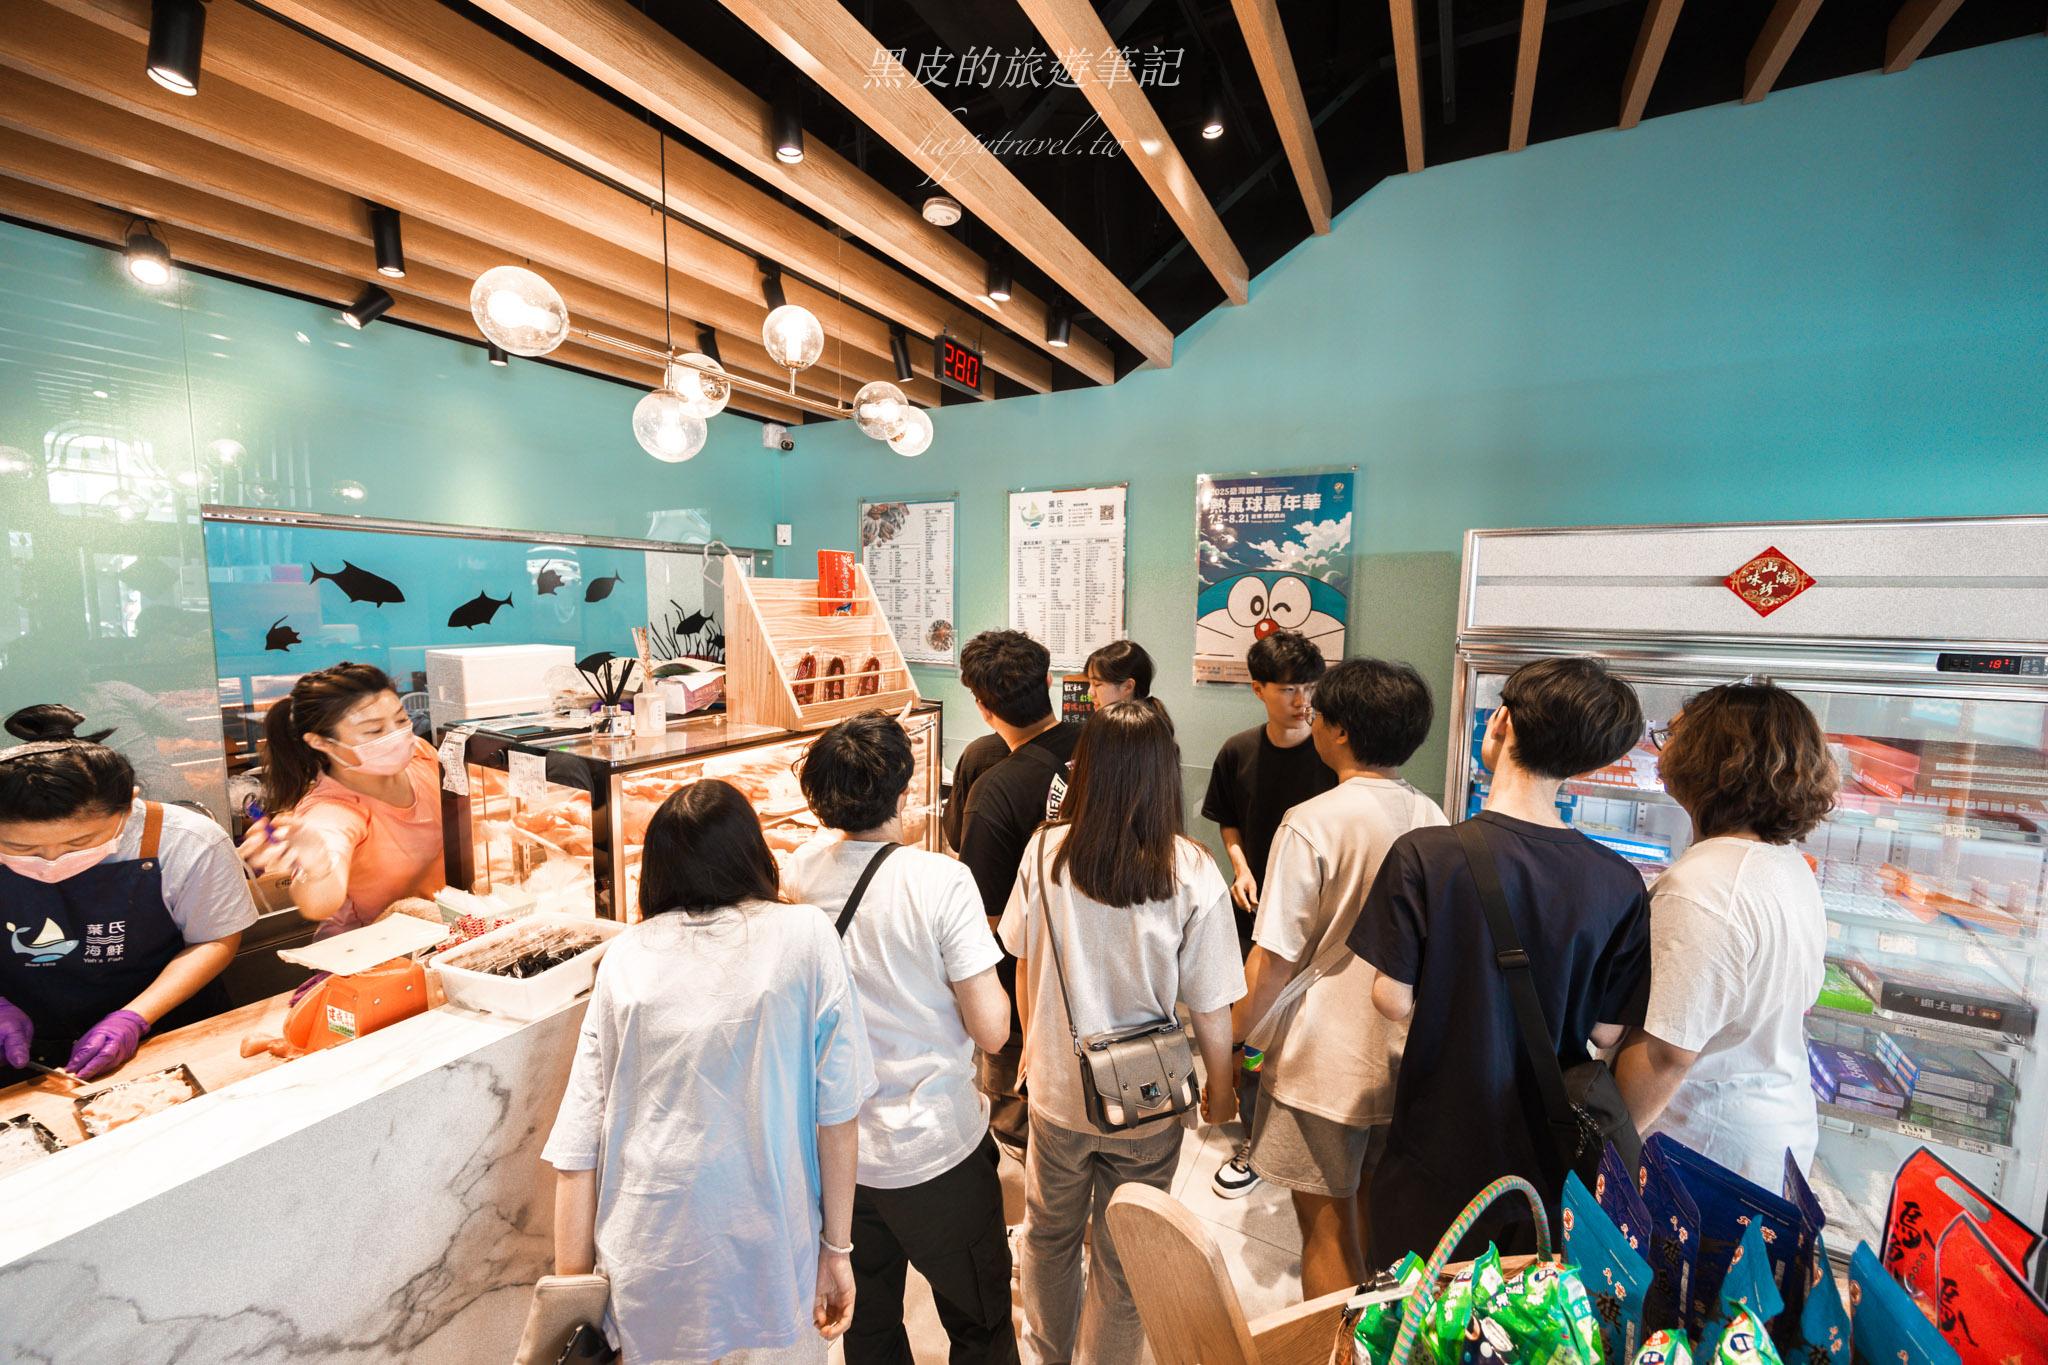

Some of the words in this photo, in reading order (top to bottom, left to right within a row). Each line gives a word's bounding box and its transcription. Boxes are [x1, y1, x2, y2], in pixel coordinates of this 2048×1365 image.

[1209, 493, 1322, 514] 熱氣球嘉年華
[1208, 514, 1249, 524] 7.5-8.21
[86, 921, 126, 935] 葉氏
[84, 944, 125, 957] 海鮮
